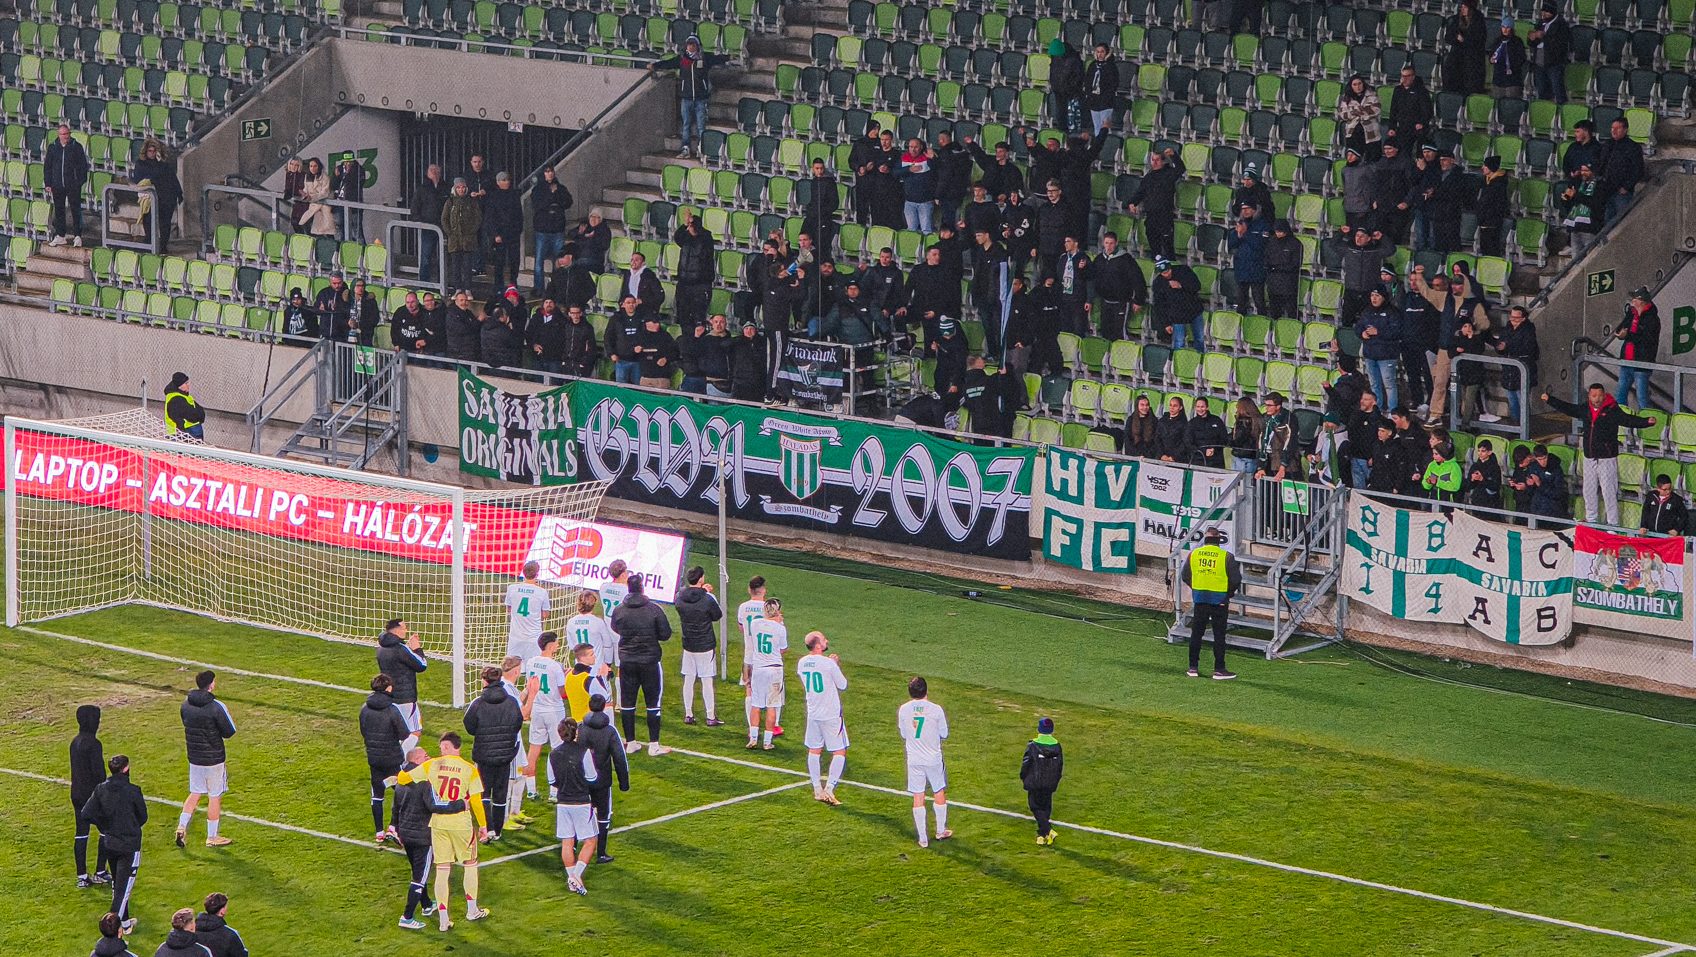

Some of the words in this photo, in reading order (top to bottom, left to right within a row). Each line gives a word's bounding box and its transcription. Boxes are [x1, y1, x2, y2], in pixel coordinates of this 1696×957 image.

[462, 379, 574, 431] SAVARIA
[768, 419, 789, 430] Green
[792, 424, 811, 434] White
[462, 426, 578, 478] ORIGINALS
[14, 449, 118, 494] LAPTOP
[150, 471, 263, 519] ASZTALI
[269, 491, 309, 525] PC
[342, 502, 477, 554] HÁLÓZAT
[851, 435, 1025, 547] 2007
[1284, 487, 1307, 506] B2
[1172, 504, 1201, 518] 1919
[1144, 517, 1230, 545] HALADS
[1199, 558, 1216, 568] 1941
[1371, 547, 1426, 574] SAVARIA
[1481, 573, 1547, 597] SAVARIA
[517, 597, 530, 617] 4
[603, 598, 620, 617] 2
[1577, 586, 1678, 616] SZOMBATHELY
[746, 614, 764, 636] 1
[576, 628, 589, 645] 11
[757, 632, 773, 654] 15
[530, 671, 550, 694] 4
[802, 671, 824, 693] 70
[913, 716, 925, 738] 7
[437, 775, 461, 801] 76
